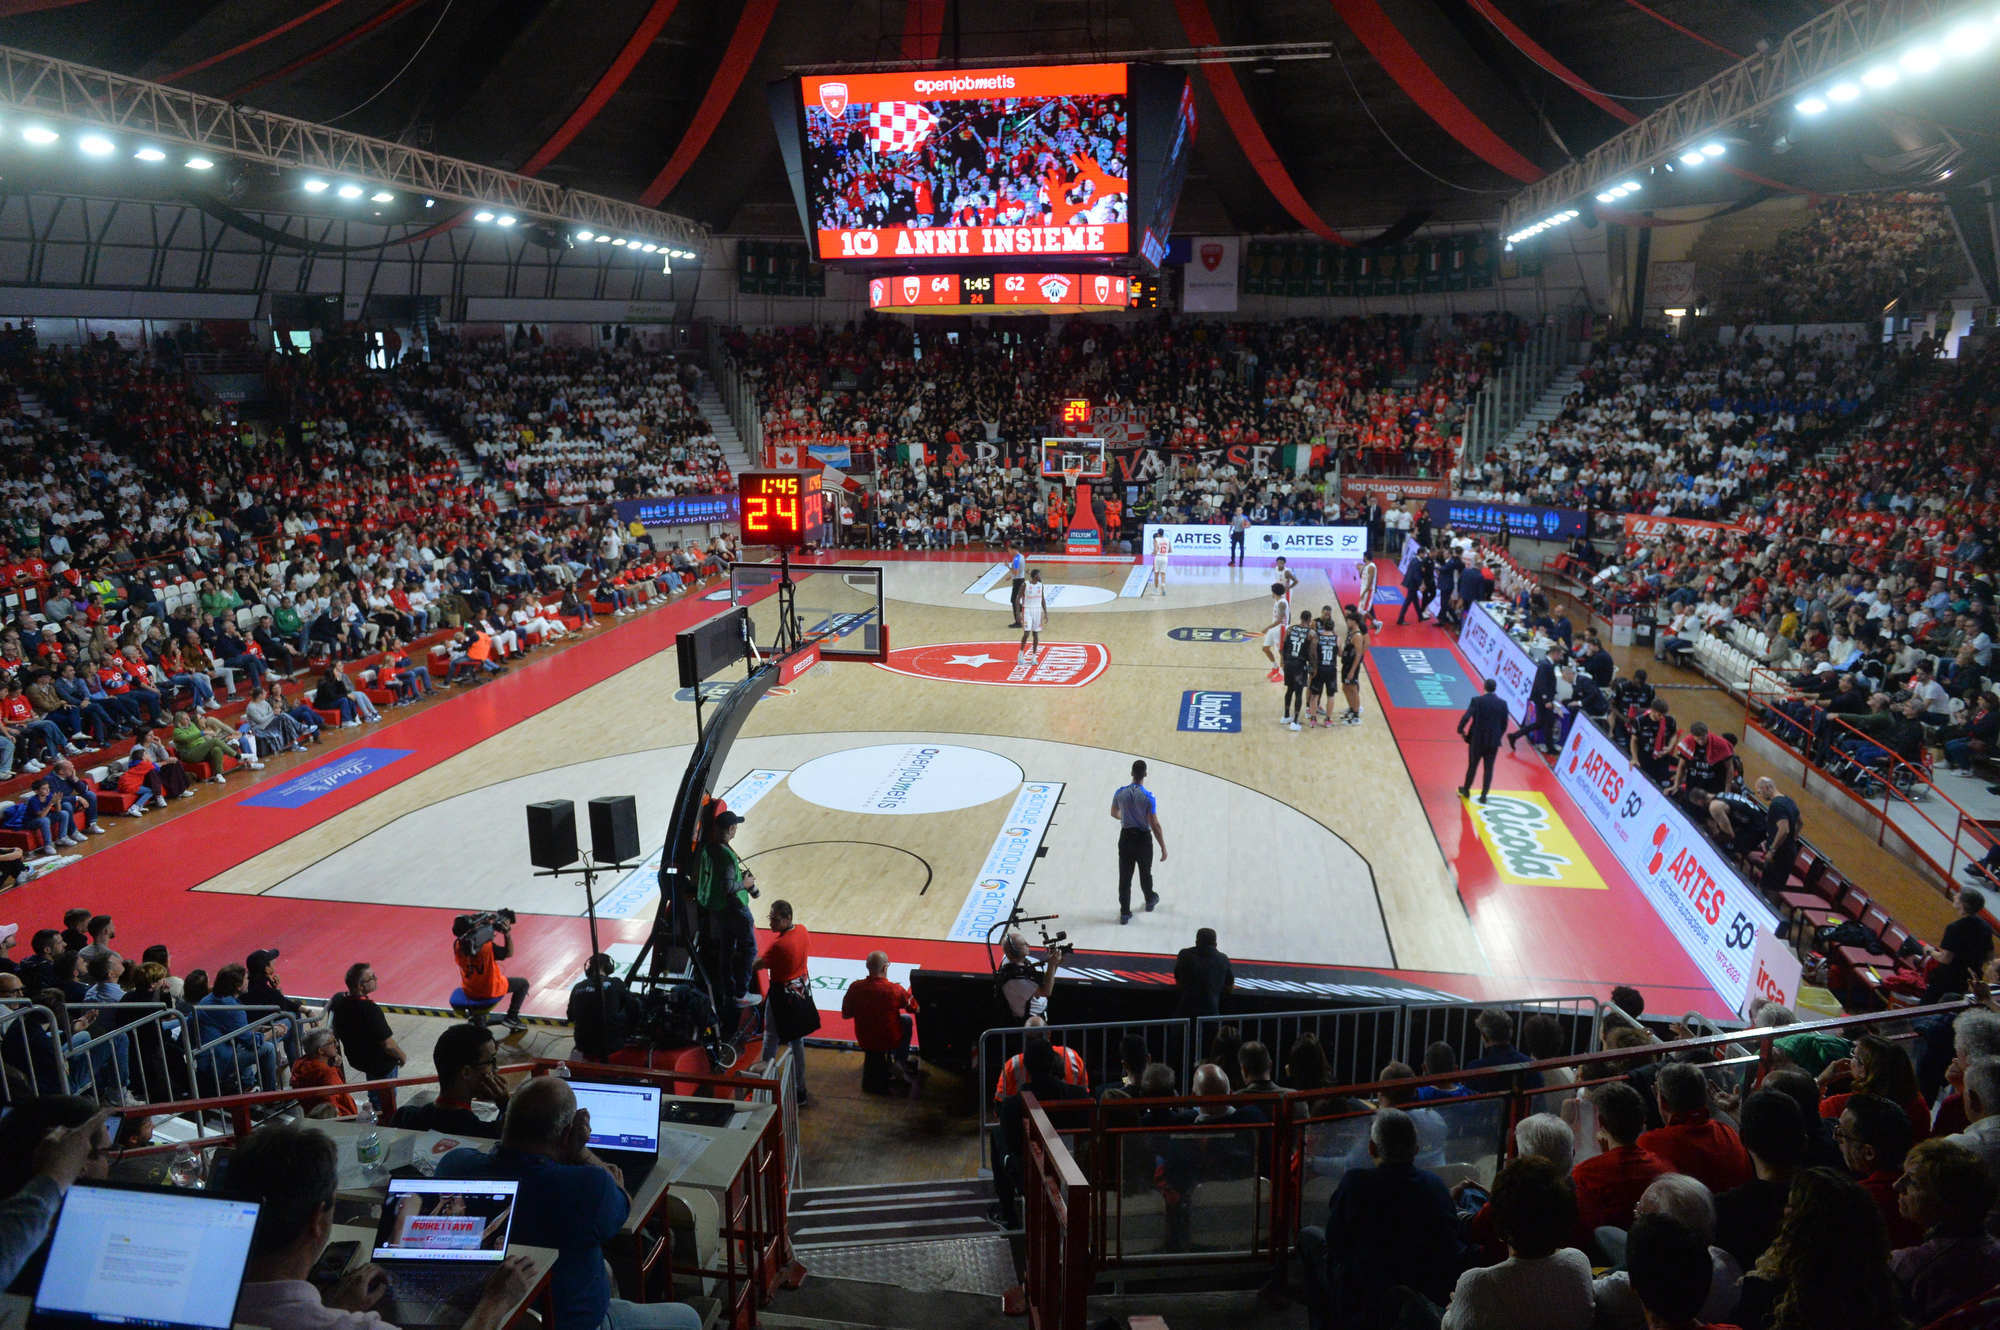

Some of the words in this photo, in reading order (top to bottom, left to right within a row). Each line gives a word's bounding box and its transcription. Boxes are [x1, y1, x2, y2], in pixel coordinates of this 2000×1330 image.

[914, 75, 1015, 94] openjobmetis
[841, 232, 879, 256] 10
[895, 229, 969, 255] ANNI
[982, 226, 1105, 253] INSIEME
[931, 277, 949, 291] 64
[964, 278, 990, 291] 1:45
[1005, 276, 1025, 291] 62
[1065, 408, 1085, 421] 24
[762, 478, 797, 494] 1:45
[747, 499, 797, 530] 24
[1174, 533, 1222, 544] ARTES
[1285, 535, 1334, 546] ARTES
[1190, 694, 1232, 730] UnipolSai
[1581, 748, 1625, 804] ARTES
[1473, 796, 1568, 878] Ricola
[996, 837, 1030, 876] acinque
[1667, 847, 1725, 926] ARTES
[967, 891, 1007, 938] acinque
[1756, 960, 1785, 1004] irca
